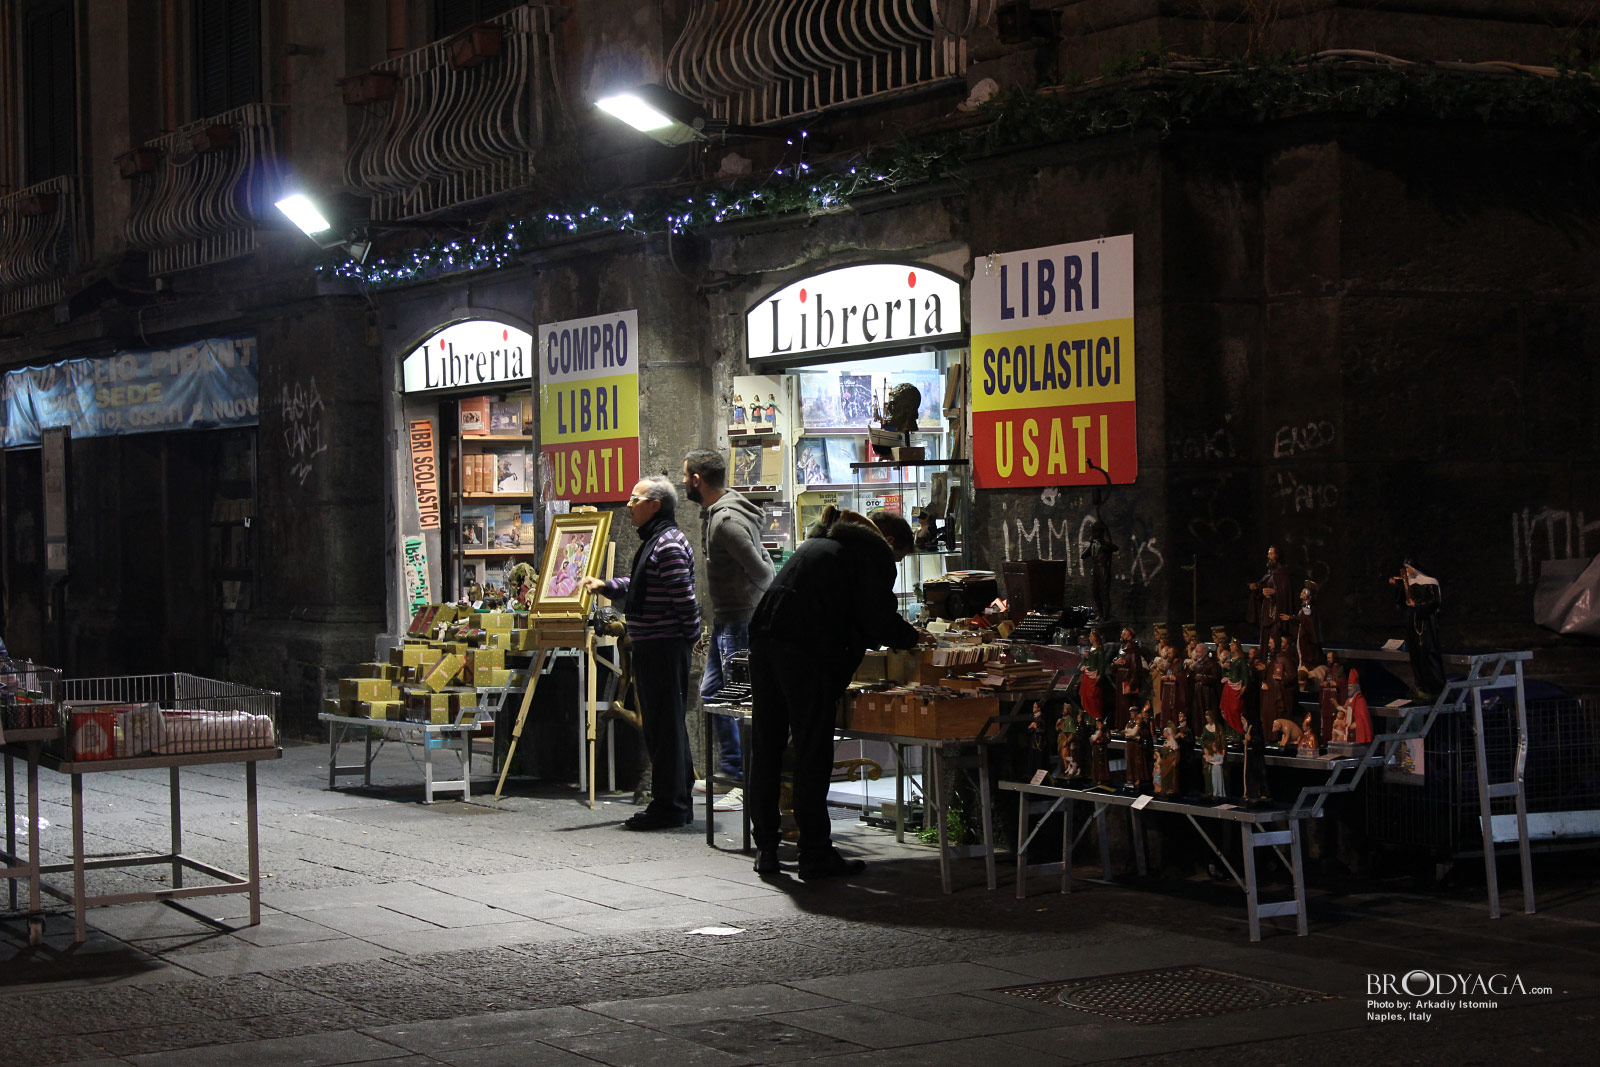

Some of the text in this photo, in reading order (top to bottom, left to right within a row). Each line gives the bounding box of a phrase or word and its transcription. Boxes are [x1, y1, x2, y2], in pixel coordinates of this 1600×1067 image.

[769, 271, 944, 353] Libreria
[1000, 251, 1100, 320] LIBRI
[423, 329, 524, 389] Libreria
[547, 320, 628, 375] COMPRO
[983, 336, 1121, 396] SCOLASTICI
[96, 382, 163, 408] SEDE
[557, 385, 619, 434] LIBRI
[410, 421, 440, 528] LIBRI SCOLASTICI
[554, 447, 624, 497] USATI
[995, 414, 1110, 478] USATI
